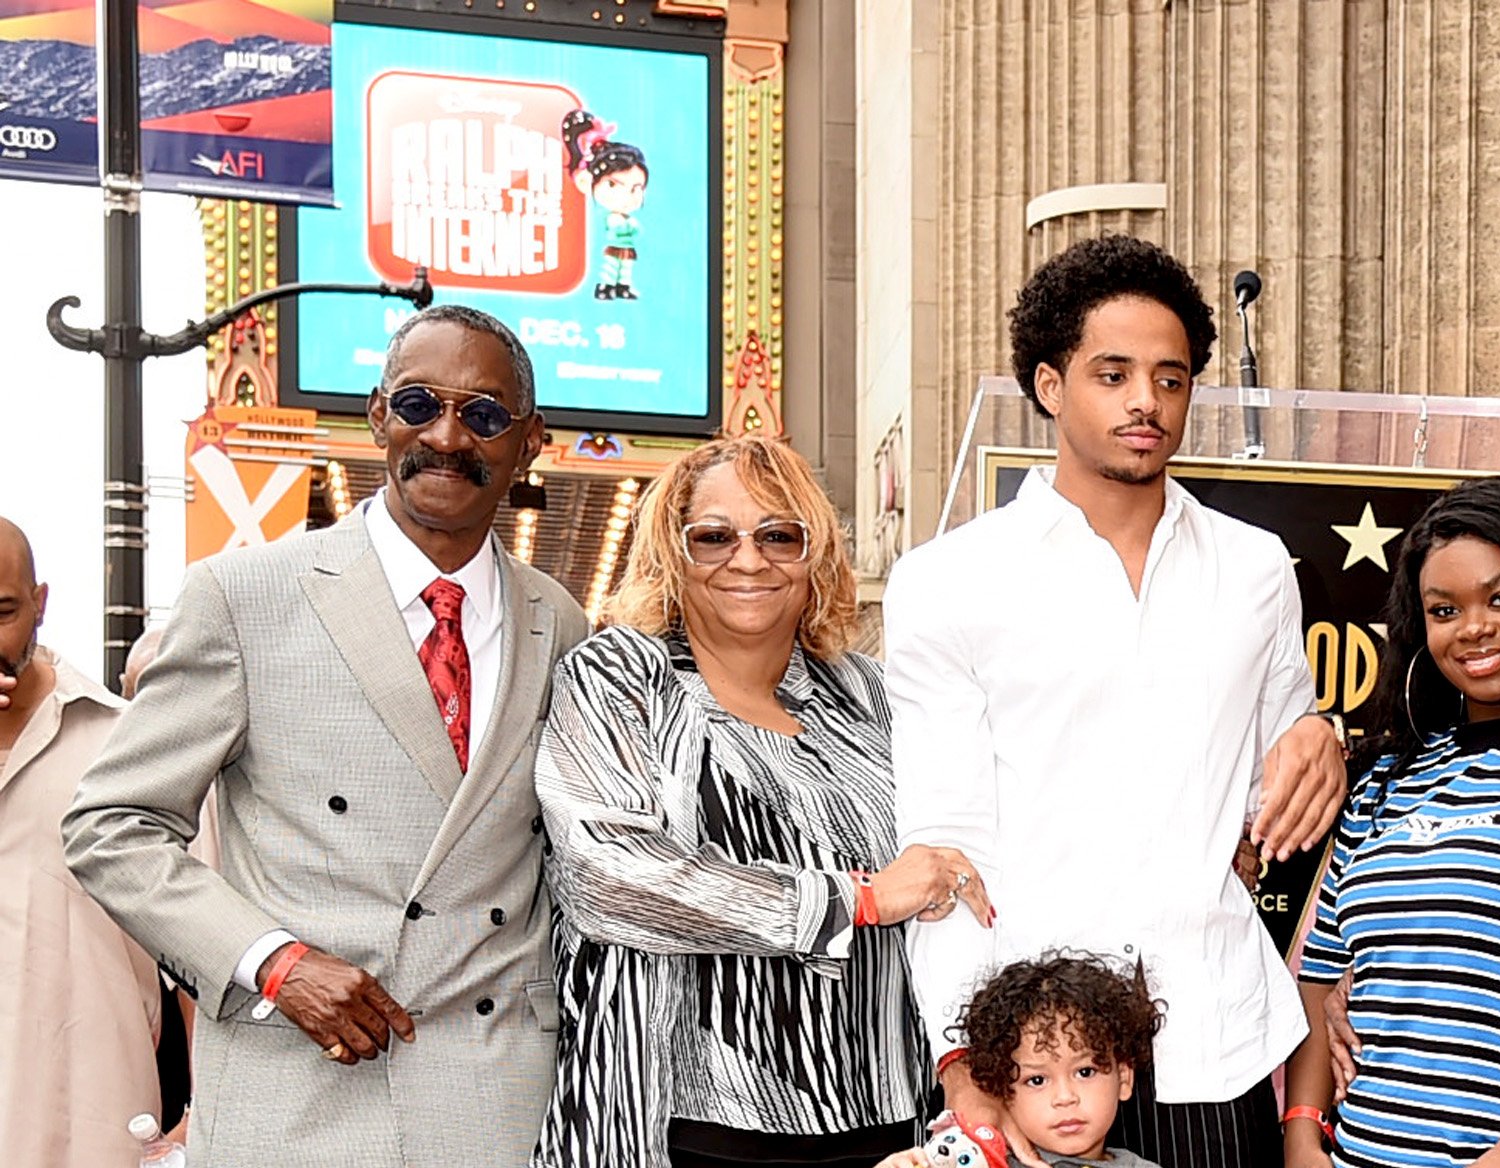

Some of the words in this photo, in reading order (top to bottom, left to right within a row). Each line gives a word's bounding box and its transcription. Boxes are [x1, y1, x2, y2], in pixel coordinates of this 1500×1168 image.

[220, 150, 263, 179] AFI
[391, 118, 563, 190] RALPH
[391, 204, 562, 277] INTERNET
